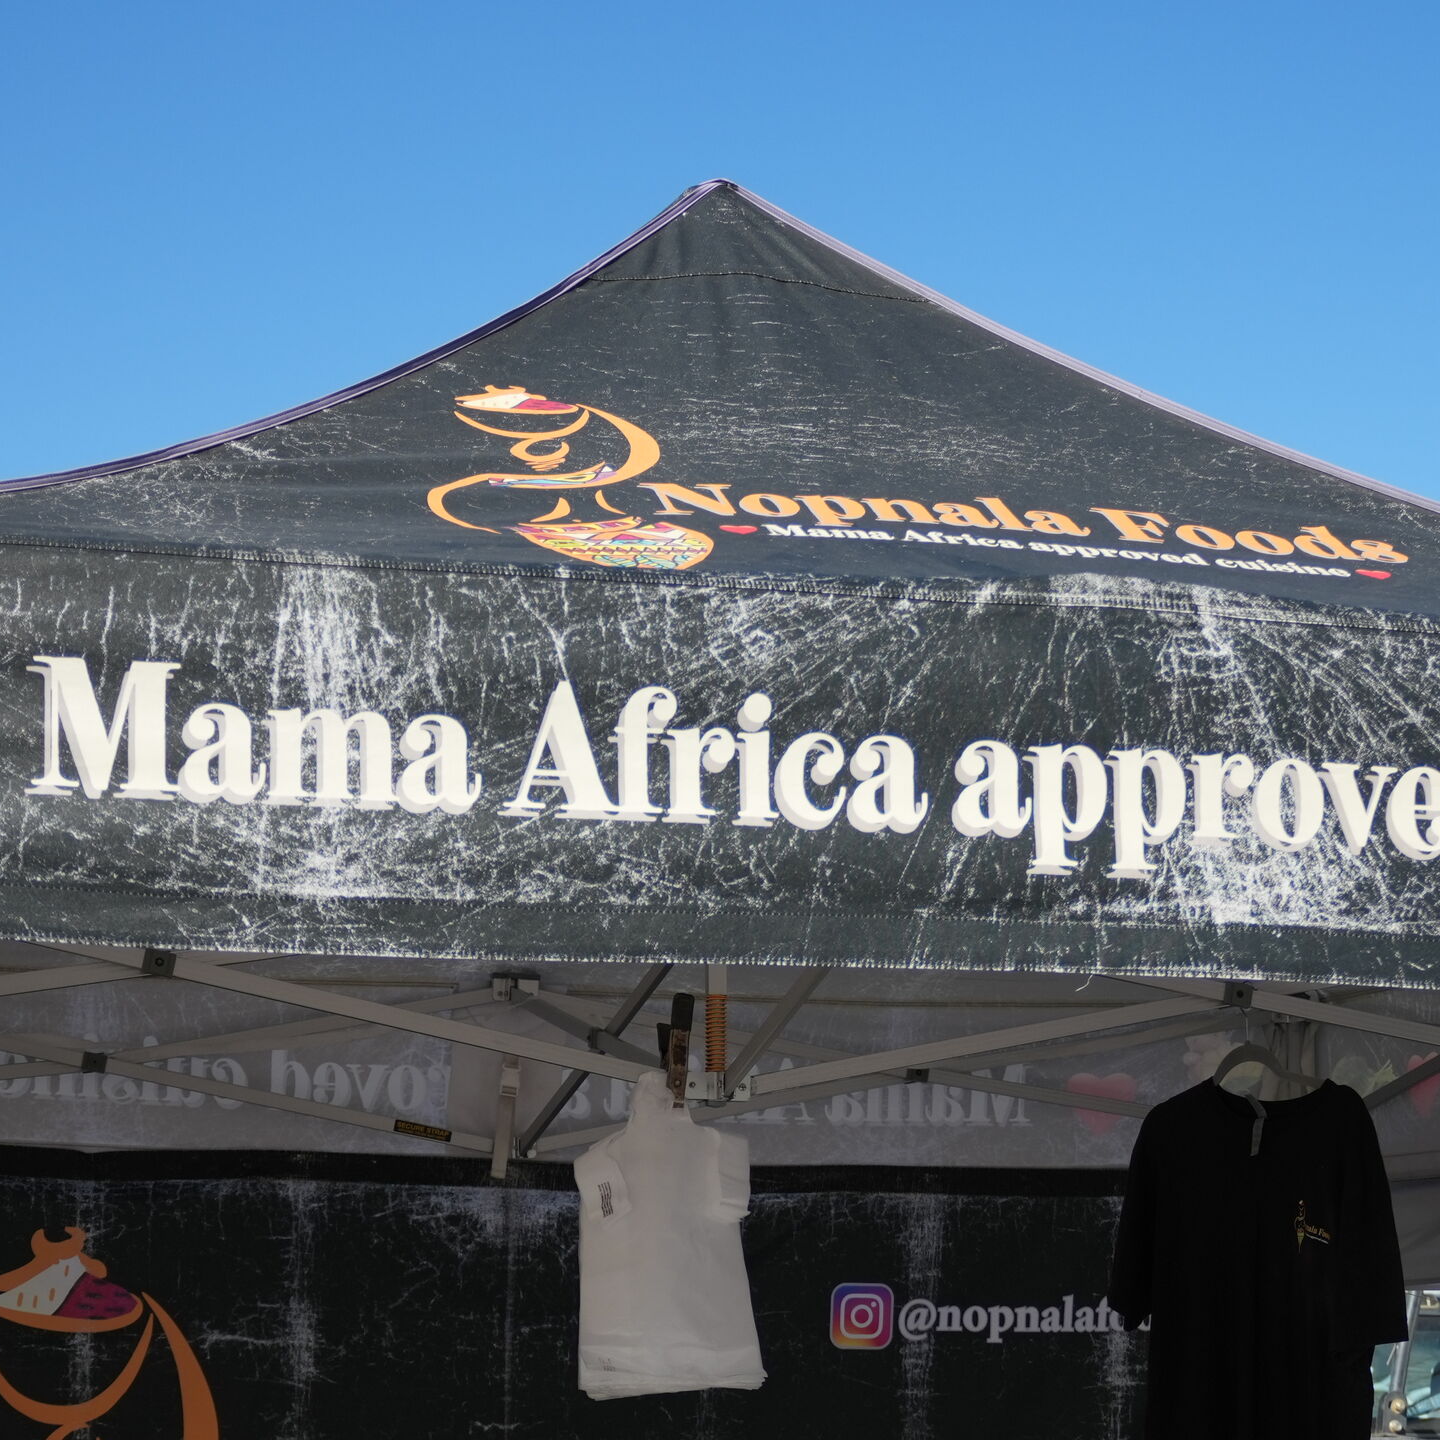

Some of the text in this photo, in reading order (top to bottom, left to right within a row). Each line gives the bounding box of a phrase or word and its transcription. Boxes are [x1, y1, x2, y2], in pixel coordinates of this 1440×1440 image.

[638, 482, 1409, 566] Nopnala Foods
[760, 523, 1351, 579] Mama Africa approved cuisine
[23, 655, 481, 815] Mama
[498, 679, 930, 834] Africa
